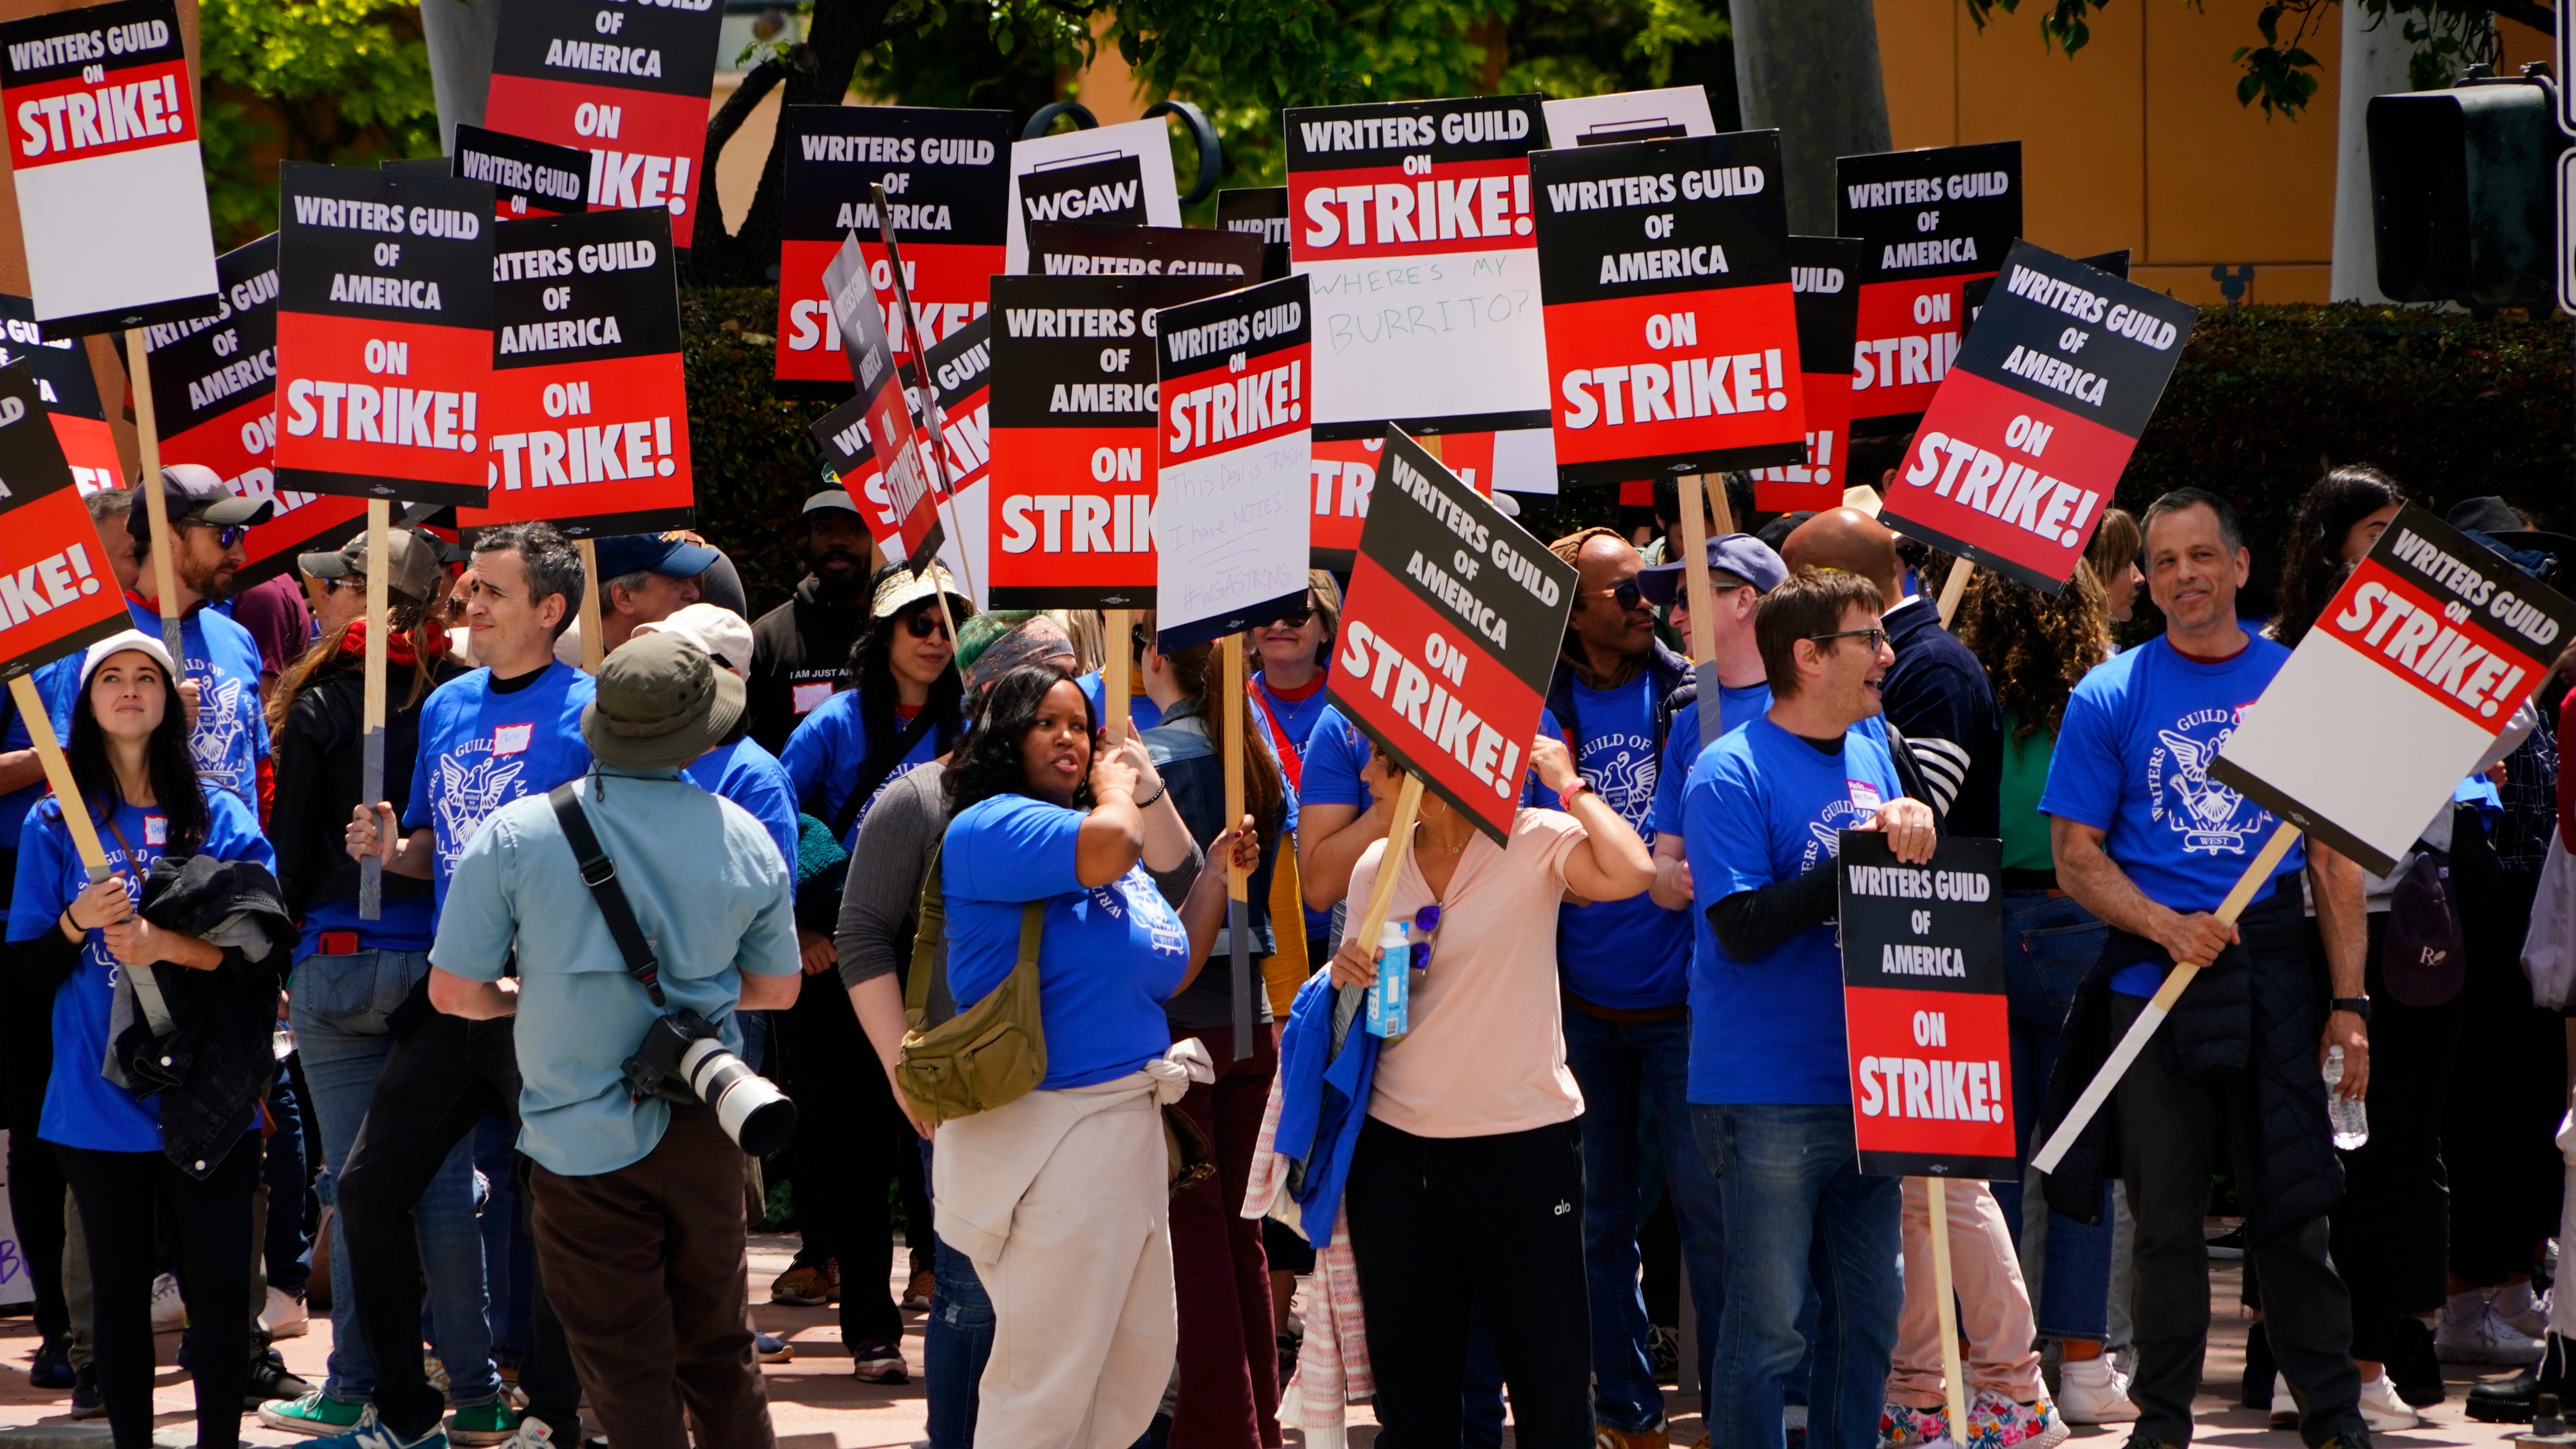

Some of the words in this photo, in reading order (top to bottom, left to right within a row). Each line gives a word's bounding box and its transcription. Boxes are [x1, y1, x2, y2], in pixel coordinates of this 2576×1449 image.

[596, 11, 624, 34] OF
[9, 30, 104, 71] WRITERS
[107, 20, 168, 54] GUILD
[545, 39, 661, 77] AMERICA
[83, 64, 104, 83] ON
[18, 75, 182, 156] STRIKE!
[575, 103, 621, 138] ON
[1301, 116, 1435, 152] WRITERS
[1442, 110, 1528, 143] GUILD
[801, 135, 915, 163] WRITERS
[921, 138, 994, 165] GUILD
[1404, 155, 1431, 175] ON
[464, 150, 532, 190] WRITERS
[535, 166, 580, 200] GUILD
[587, 148, 691, 216] IKE!
[883, 173, 909, 193] OF
[1547, 174, 1676, 212] WRITERS
[1682, 167, 1764, 200] GUILD
[1848, 178, 1943, 209] WRITERS
[1947, 172, 2008, 199] GUILD
[294, 196, 404, 233] WRITERS
[410, 207, 478, 240] GUILD
[511, 195, 527, 214] ON
[1026, 180, 1138, 220] WGAW
[1305, 175, 1532, 247] STRIKE!
[1645, 214, 1673, 239] OF
[1918, 211, 1939, 231] OF
[374, 243, 399, 266] OF
[494, 247, 573, 282] RITERS
[578, 240, 656, 273] GUILD
[1600, 245, 1728, 284] AMERICA
[1882, 237, 1977, 269] AMERICA
[330, 274, 441, 310] AMERICA
[853, 266, 867, 300] GUILD
[1310, 263, 1443, 295] WHERE'S
[1473, 255, 1507, 276] MY
[1792, 266, 1845, 294] UILD
[543, 287, 570, 310] OF
[1914, 293, 1950, 324] ON
[2008, 264, 2108, 323] WRITERS
[2106, 304, 2176, 350] GUILD
[501, 316, 621, 354] AMERICA
[1006, 309, 1135, 336] WRITERS
[1168, 320, 1249, 362] WRITERS
[1253, 302, 1301, 340] GUILD
[1328, 290, 1529, 355] BURRITO?
[1646, 312, 1697, 349] ON
[2060, 328, 2089, 353] OF
[213, 329, 237, 356] OF
[365, 340, 407, 375] ON
[1101, 349, 1130, 372] OF
[188, 346, 278, 410] AMERIC
[859, 343, 883, 391] AMERICA
[937, 337, 990, 390] GUIL
[1229, 352, 1245, 373] ON
[2002, 345, 2108, 406] AMERICA
[543, 382, 591, 417] ON
[1050, 384, 1158, 413] AMERIC
[1170, 360, 1301, 453] STRIKE!
[1562, 349, 1786, 429] STRIKE!
[287, 379, 477, 452] STRIKE!
[882, 409, 897, 446] ON
[2005, 415, 2054, 457] ON
[885, 434, 928, 528] STRIKE!
[1091, 448, 1141, 482] ON
[1168, 473, 1214, 503] This
[1221, 463, 1245, 490] Deal
[1251, 464, 1260, 481] is
[1263, 445, 1303, 471] TRASH
[1905, 431, 2099, 547] STRIKE!
[1001, 494, 1158, 553] STRIK
[1169, 526, 1187, 551] I
[1192, 519, 1226, 542] have
[1234, 488, 1288, 529] NOTES!
[1392, 453, 1489, 553] WRITERS
[1492, 540, 1559, 607] GUILD
[1454, 550, 1479, 581] OF
[0, 543, 100, 632] IKE!
[1183, 563, 1291, 611] #WGASTRONG
[1406, 550, 1506, 650] AMERICA
[2392, 528, 2496, 606] WRITERS
[2490, 592, 2559, 645] GUILD
[2445, 601, 2471, 625] ON
[1425, 633, 1467, 687] ON
[2336, 582, 2526, 718] STRIKE!
[795, 670, 810, 679] AM
[812, 669, 837, 677] JUST
[1341, 618, 1520, 798] STRIKE!
[2177, 709, 2228, 731] GUILD
[1579, 734, 1625, 761] GUILD
[1628, 735, 1652, 752] OF
[2148, 747, 2166, 822] WRITERS
[1822, 800, 1854, 823] GUILD
[2199, 837, 2229, 846] WEST
[1849, 865, 1932, 899] WRITERS
[1935, 871, 1989, 901] GUILD
[1912, 910, 1930, 934] OF
[1882, 945, 1965, 977] AMERICA
[1914, 1011, 1946, 1046] ON
[1860, 1056, 2003, 1123] STRIKE!
[1554, 1199, 1571, 1216] alo
